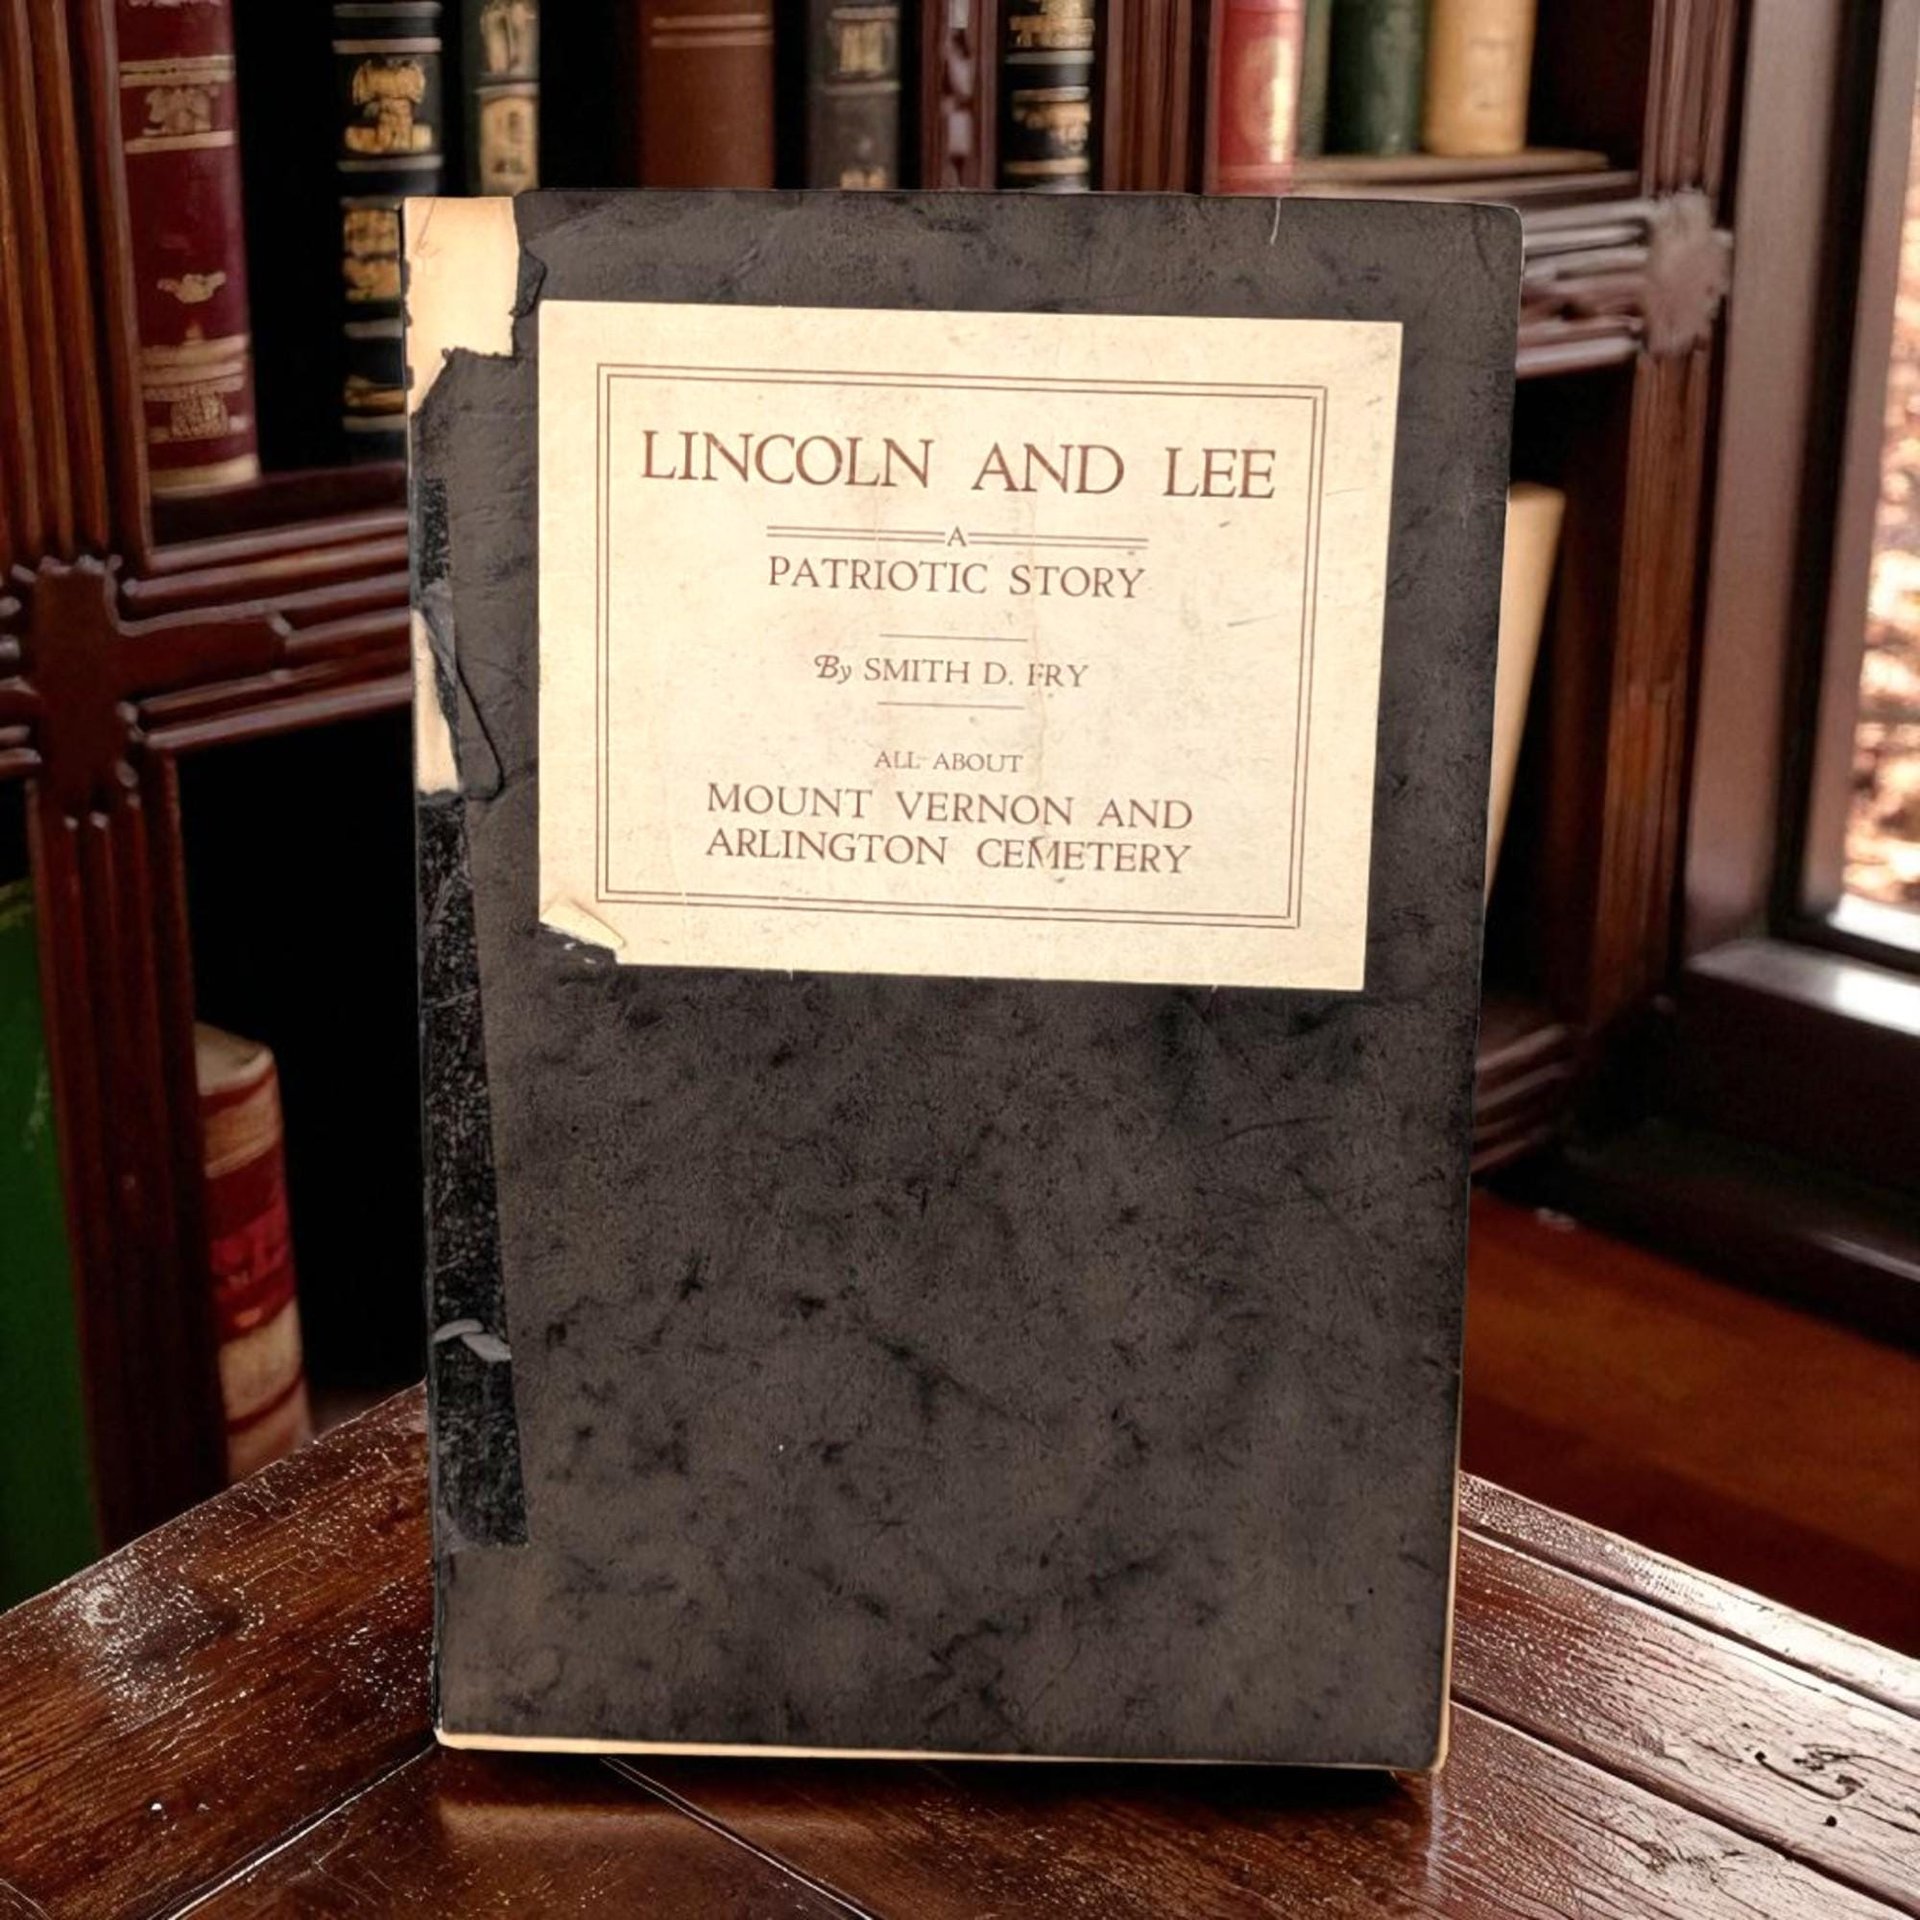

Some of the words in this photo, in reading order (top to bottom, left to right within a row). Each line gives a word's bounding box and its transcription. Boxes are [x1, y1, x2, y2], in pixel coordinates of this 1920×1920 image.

[641, 430, 935, 489] LINCOLN
[970, 442, 1125, 495] AND
[1162, 446, 1276, 500] LEE
[947, 526, 967, 547] A
[769, 555, 988, 594] PATRIOTIC
[1009, 564, 1145, 599] STORY
[814, 654, 852, 685] By
[864, 657, 970, 684] SMITH
[983, 661, 1014, 686] D.
[1027, 663, 1089, 688] FRY
[874, 750, 921, 769] ALL
[932, 752, 1023, 773] ABOUT
[707, 782, 873, 819] MOUNT
[895, 790, 1074, 826] VERNON
[1097, 798, 1193, 830] AND
[705, 827, 948, 865] ARLINGTON
[976, 836, 1192, 874] CEMETERY
